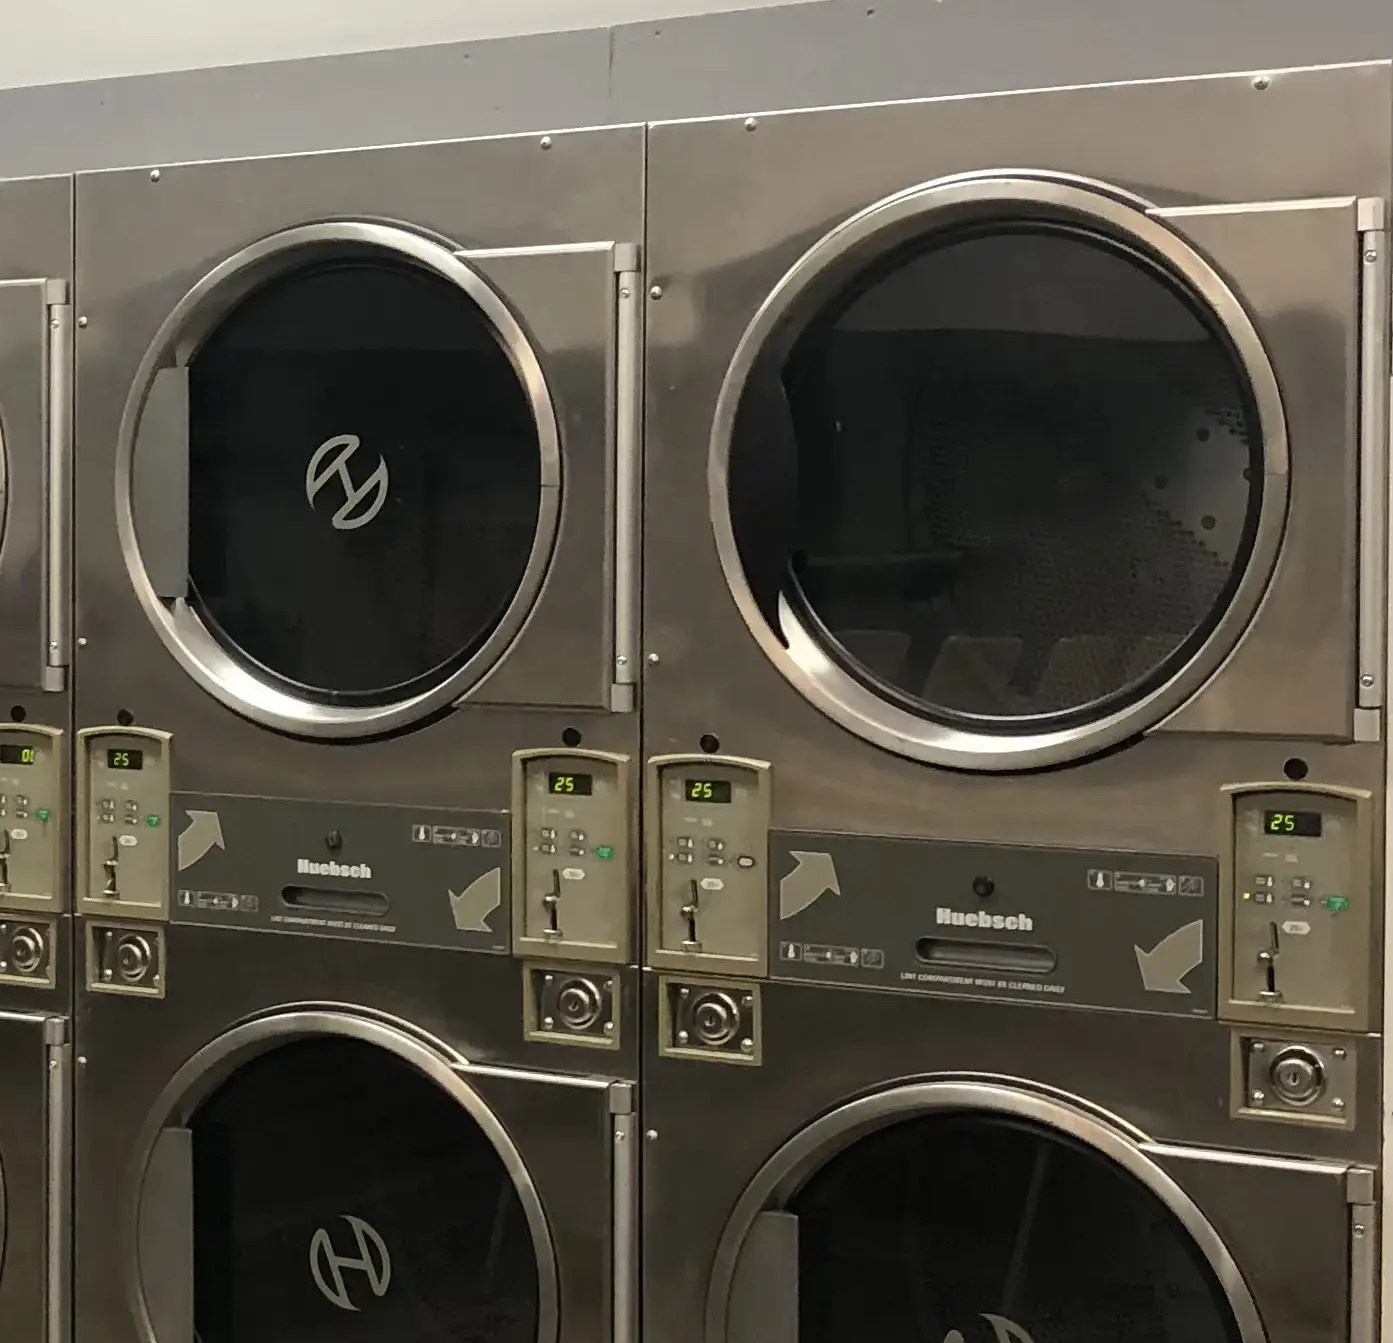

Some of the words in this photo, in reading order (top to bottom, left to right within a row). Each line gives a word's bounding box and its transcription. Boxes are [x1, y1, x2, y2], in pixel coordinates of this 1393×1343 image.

[113, 752, 130, 767] 25
[554, 776, 574, 792] 25
[691, 782, 712, 798] 25
[1270, 813, 1294, 831] 25
[296, 858, 372, 879] Huebsch
[936, 907, 1033, 931] Huebsch
